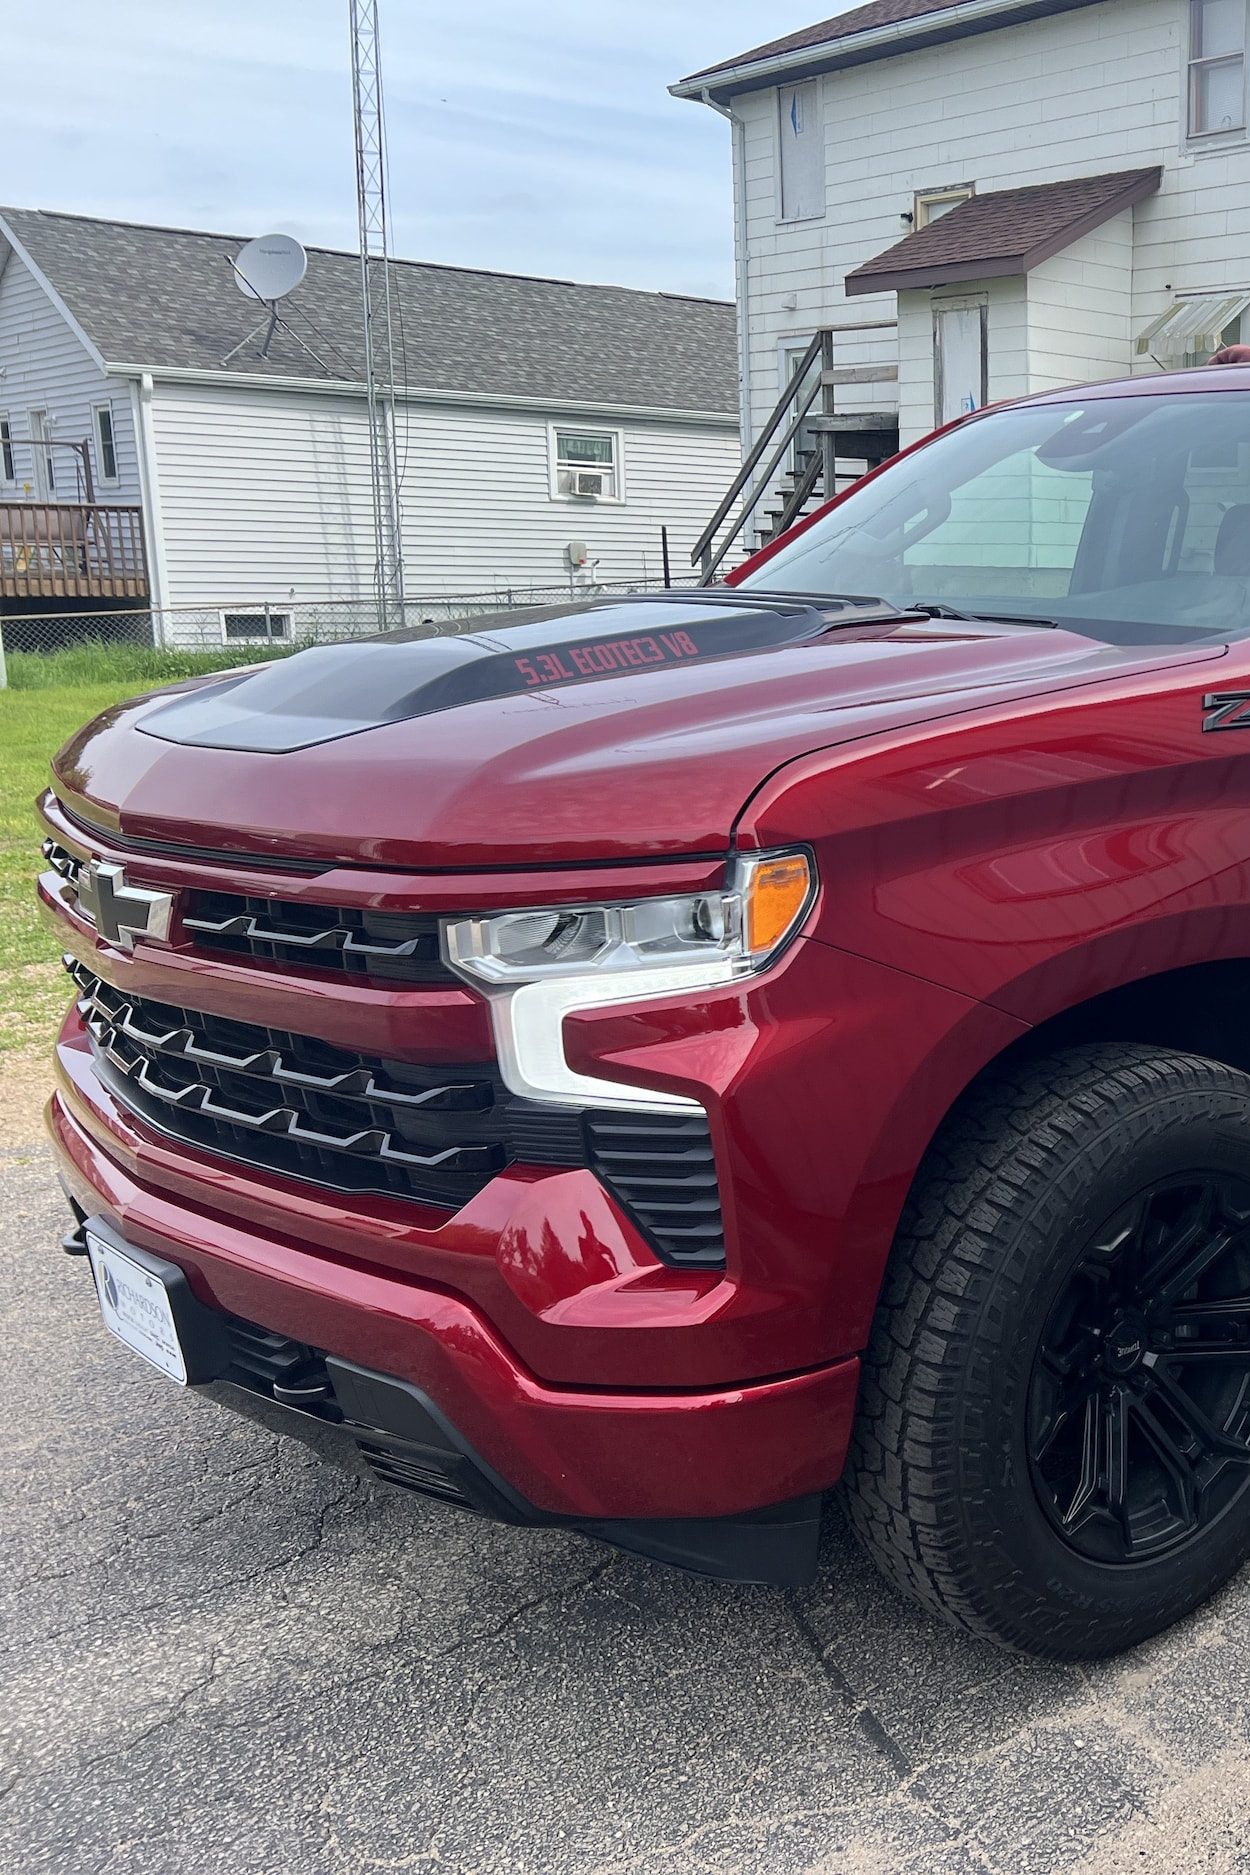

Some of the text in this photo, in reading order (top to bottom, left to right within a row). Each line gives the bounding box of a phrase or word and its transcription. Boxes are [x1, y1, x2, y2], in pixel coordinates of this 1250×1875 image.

[514, 631, 699, 686] 5.3L ECOTEC3 V8
[116, 1278, 173, 1328] RICHARDSON
